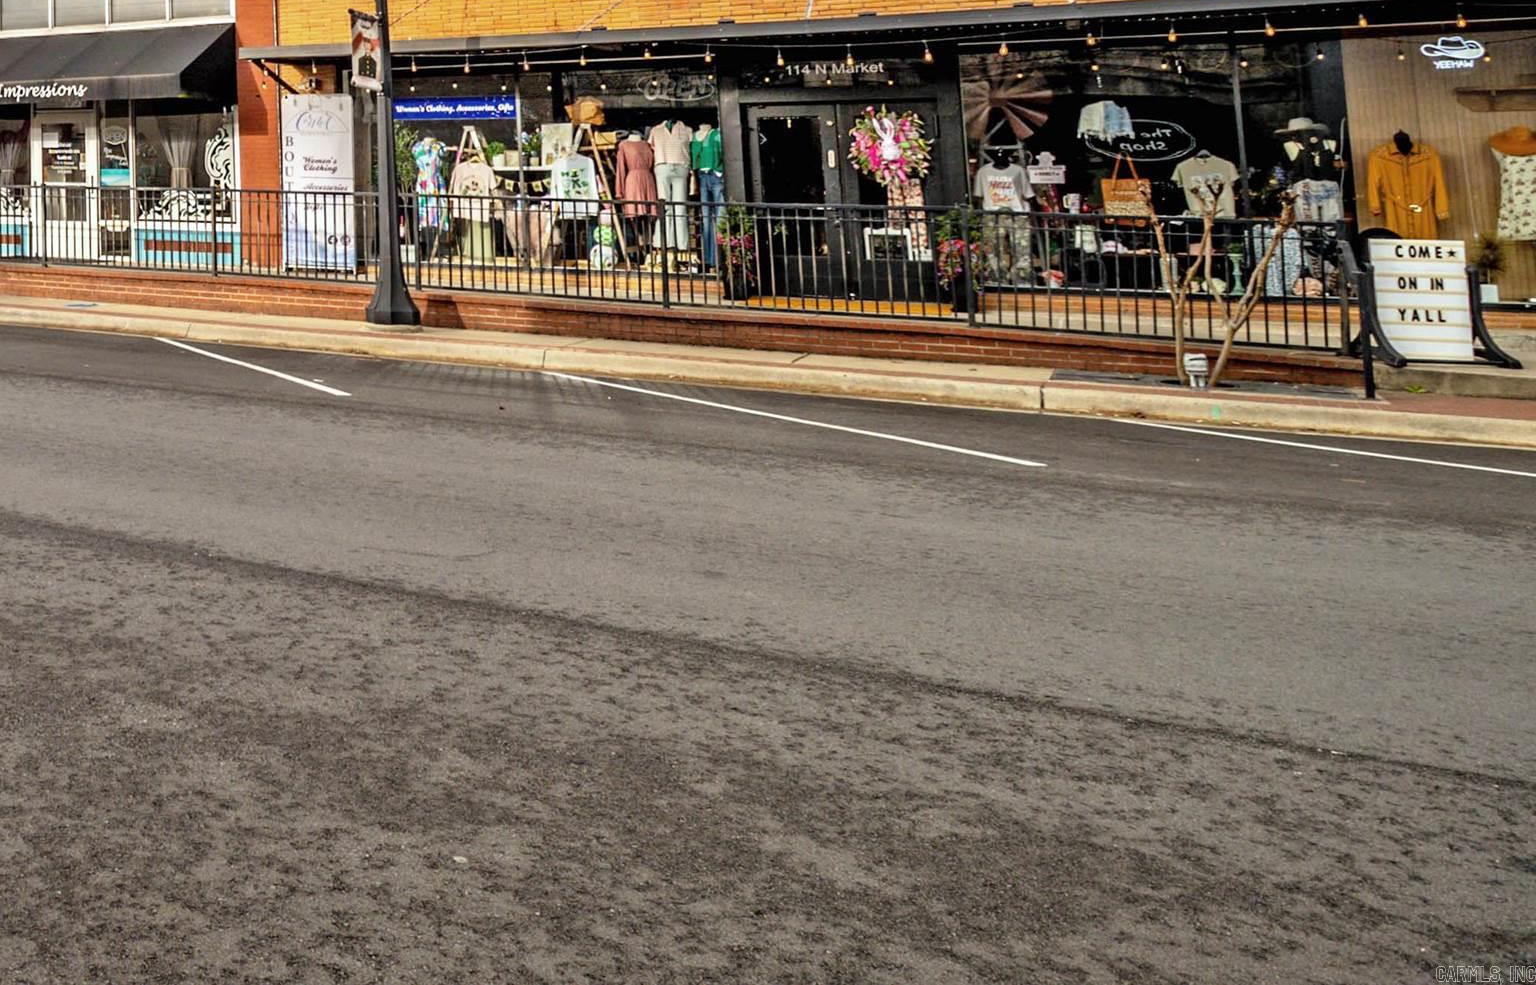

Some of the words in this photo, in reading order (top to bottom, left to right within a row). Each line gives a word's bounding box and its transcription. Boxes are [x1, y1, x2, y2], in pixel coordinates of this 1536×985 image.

[785, 64, 811, 76] 114
[815, 63, 827, 75] N
[831, 61, 884, 75] Market
[1433, 59, 1474, 69] YEEHAW
[303, 157, 337, 165] Women's
[304, 164, 337, 174] Clothing
[1395, 245, 1443, 259] COME
[1397, 276, 1418, 289] ON
[1430, 278, 1445, 290] IN
[1398, 309, 1447, 322] YALL
